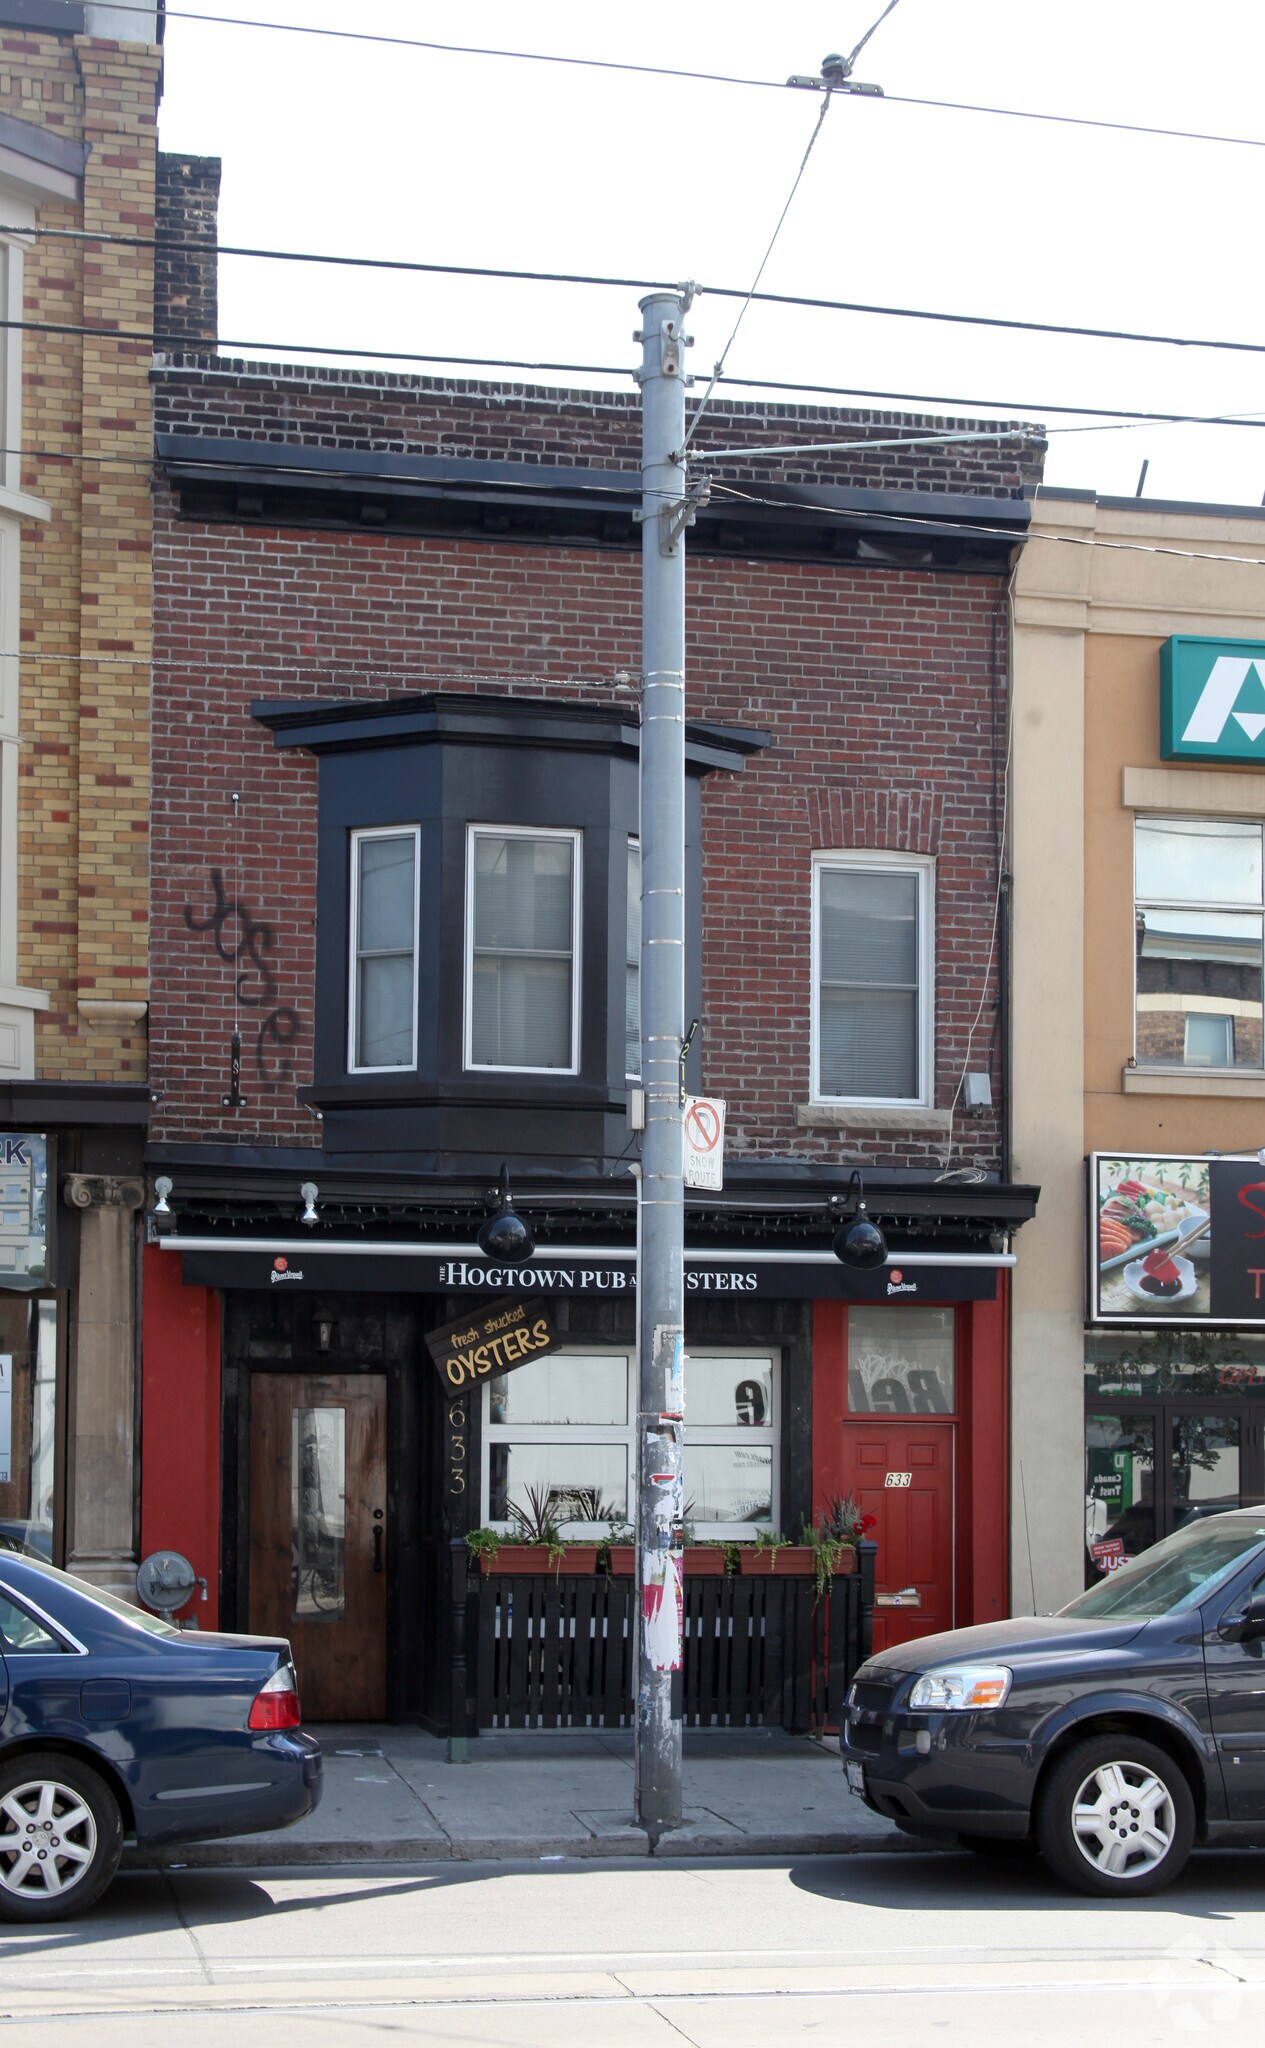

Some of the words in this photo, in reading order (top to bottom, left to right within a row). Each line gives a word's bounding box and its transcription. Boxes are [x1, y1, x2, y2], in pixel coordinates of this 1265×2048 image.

[0, 1139, 28, 1166] K
[690, 1155, 715, 1168] SNOW
[689, 1169, 716, 1185] ROUTE
[446, 1262, 574, 1288] HOGTOWN
[580, 1270, 626, 1288] PUB
[451, 1328, 479, 1349] fresh
[484, 1305, 526, 1334] shucked
[446, 1319, 550, 1385] OYSTERS
[449, 1399, 466, 1494] 633
[886, 1473, 911, 1487] 633
[1100, 1555, 1135, 1570] JUS
